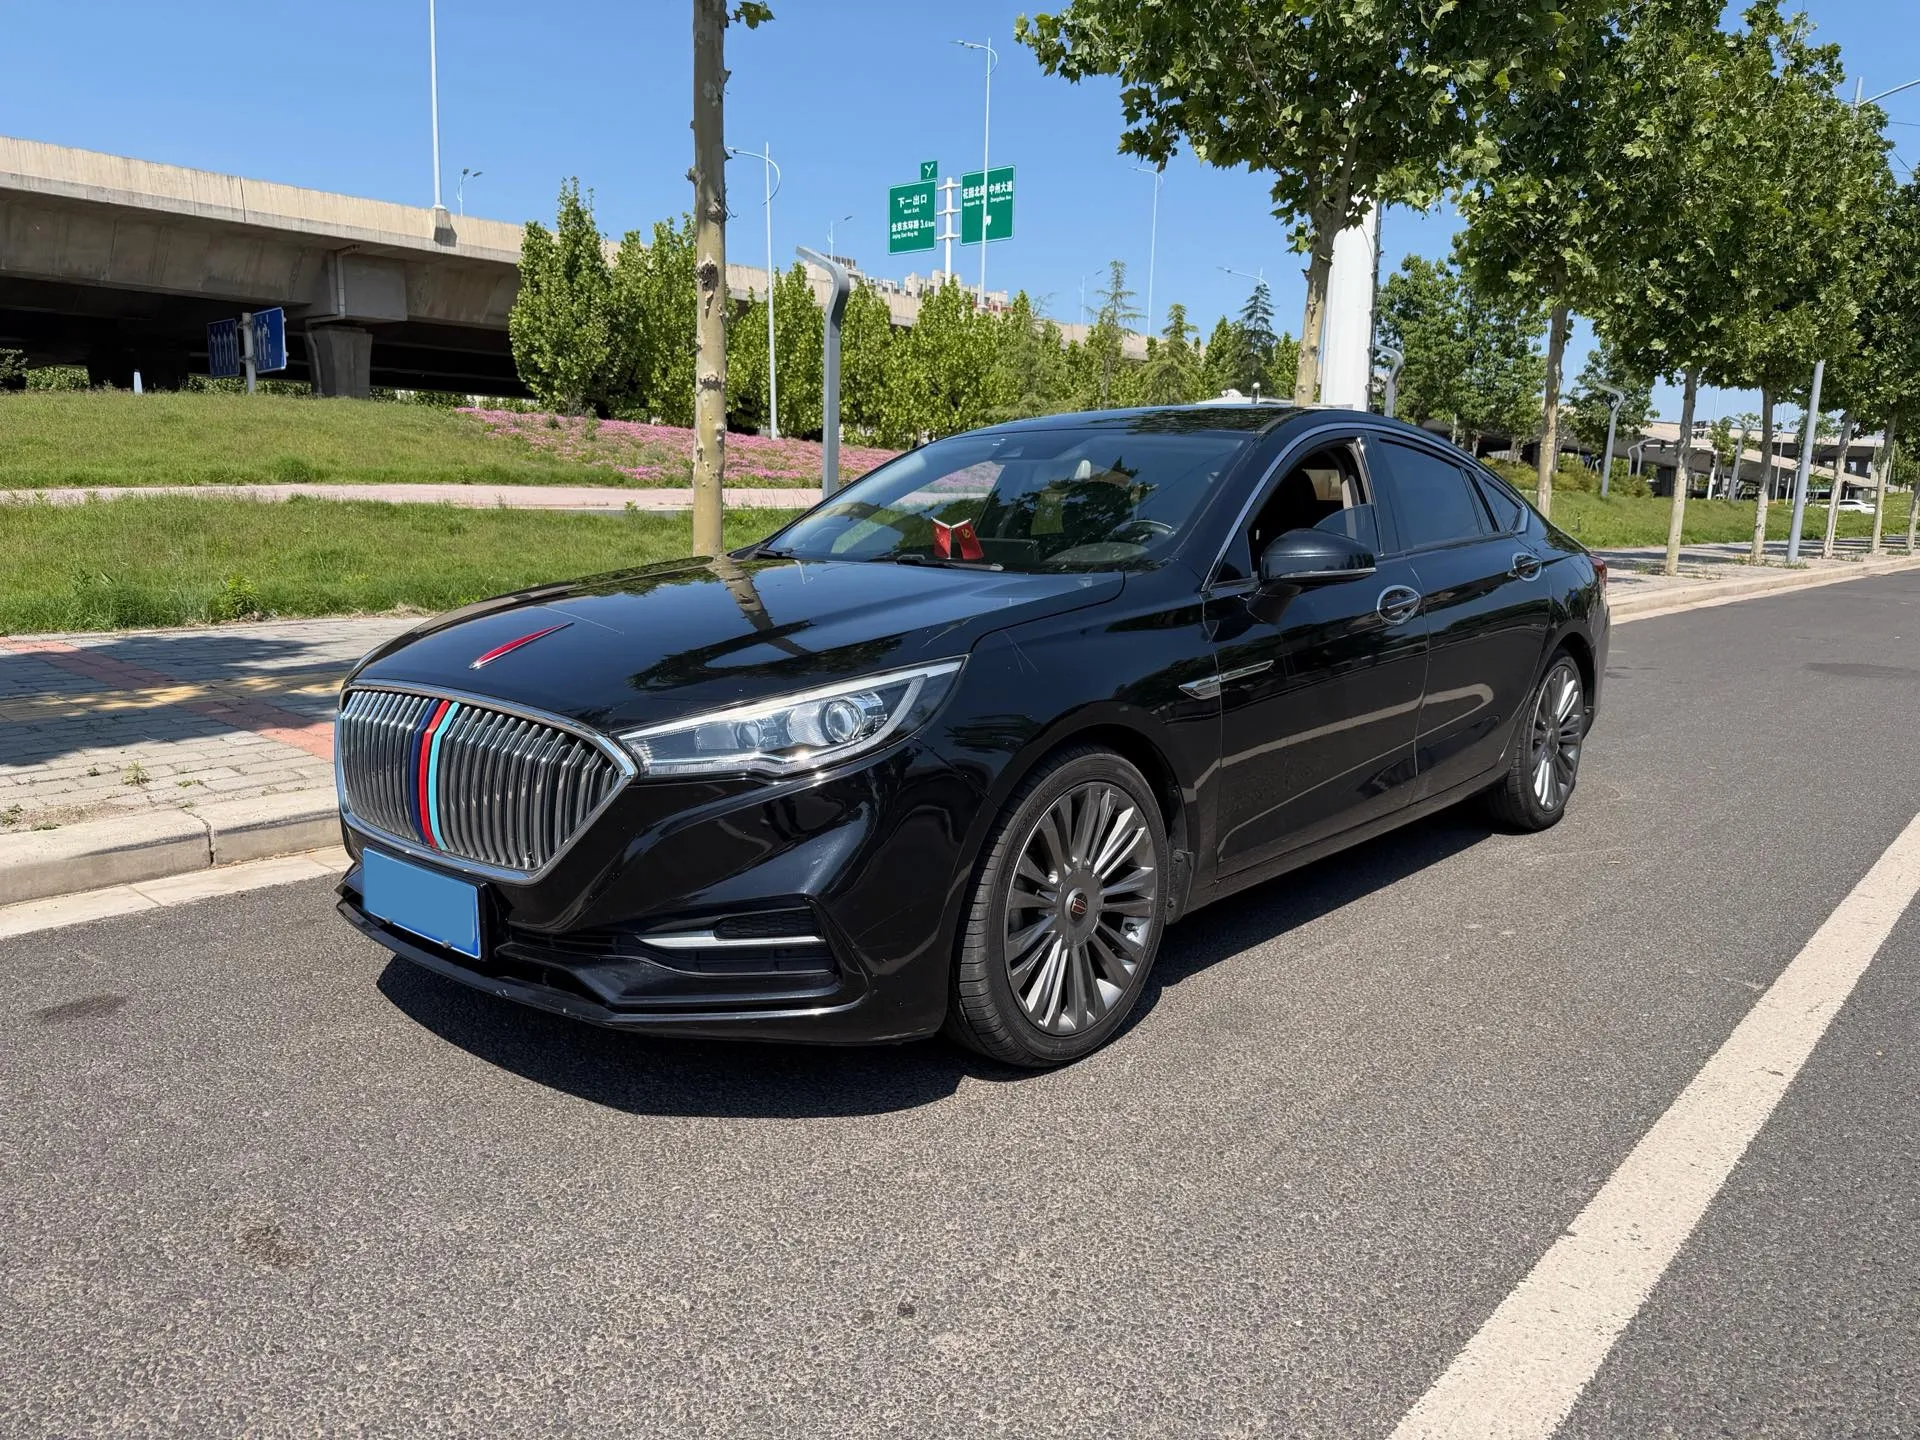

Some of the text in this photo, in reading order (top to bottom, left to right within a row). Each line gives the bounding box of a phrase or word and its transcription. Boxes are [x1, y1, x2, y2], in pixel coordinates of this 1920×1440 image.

[989, 181, 1012, 195] 中州大道
[898, 194, 927, 208] 下一出口
